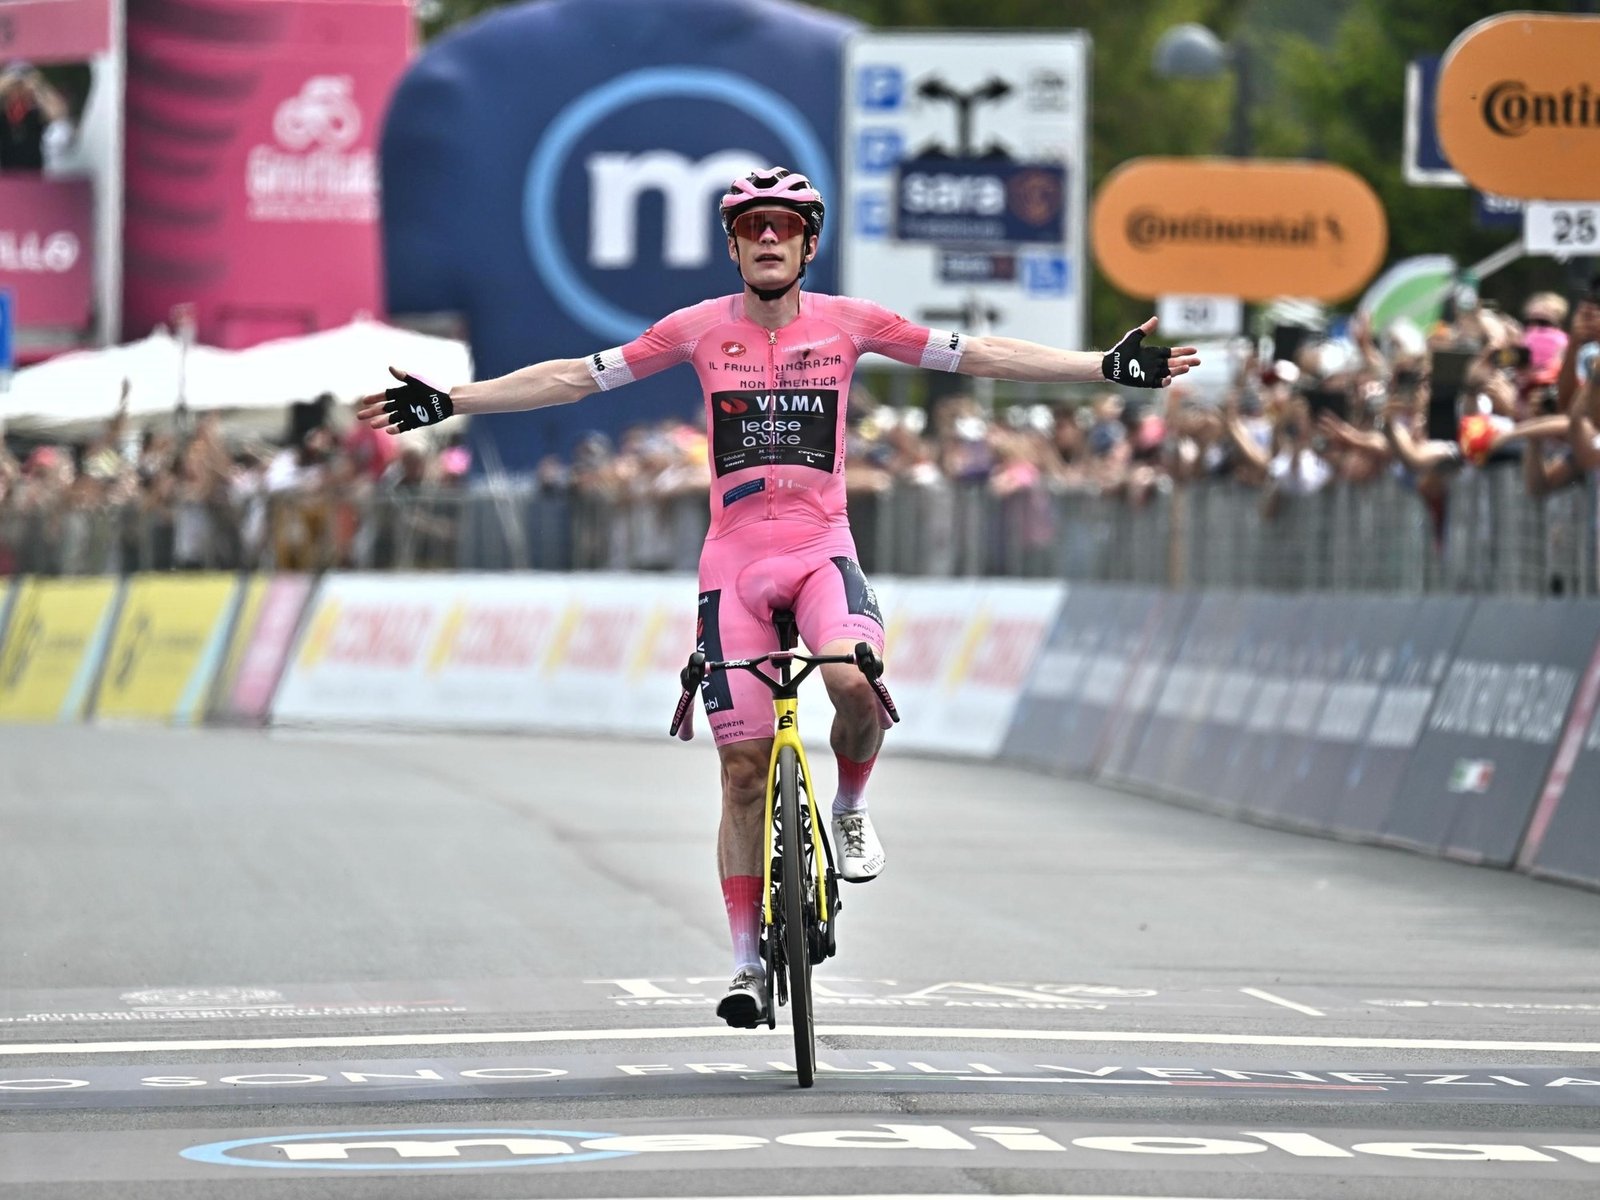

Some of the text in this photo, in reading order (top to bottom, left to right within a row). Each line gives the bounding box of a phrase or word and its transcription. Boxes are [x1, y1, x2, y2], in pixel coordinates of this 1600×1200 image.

[1482, 79, 1600, 138] Conti
[1553, 210, 1598, 246] 25
[709, 354, 842, 373] IL FRIULI RINGRAZIA
[1113, 351, 1121, 380] nimbl
[740, 376, 837, 389] NON DIMENTICA
[775, 372, 784, 380] E
[755, 395, 824, 413] VISMA
[741, 420, 801, 434] lease
[139, 1066, 569, 1088] SONO
[614, 1061, 1002, 1076] FRIULI
[1033, 1064, 1600, 1087] VENEZIA
